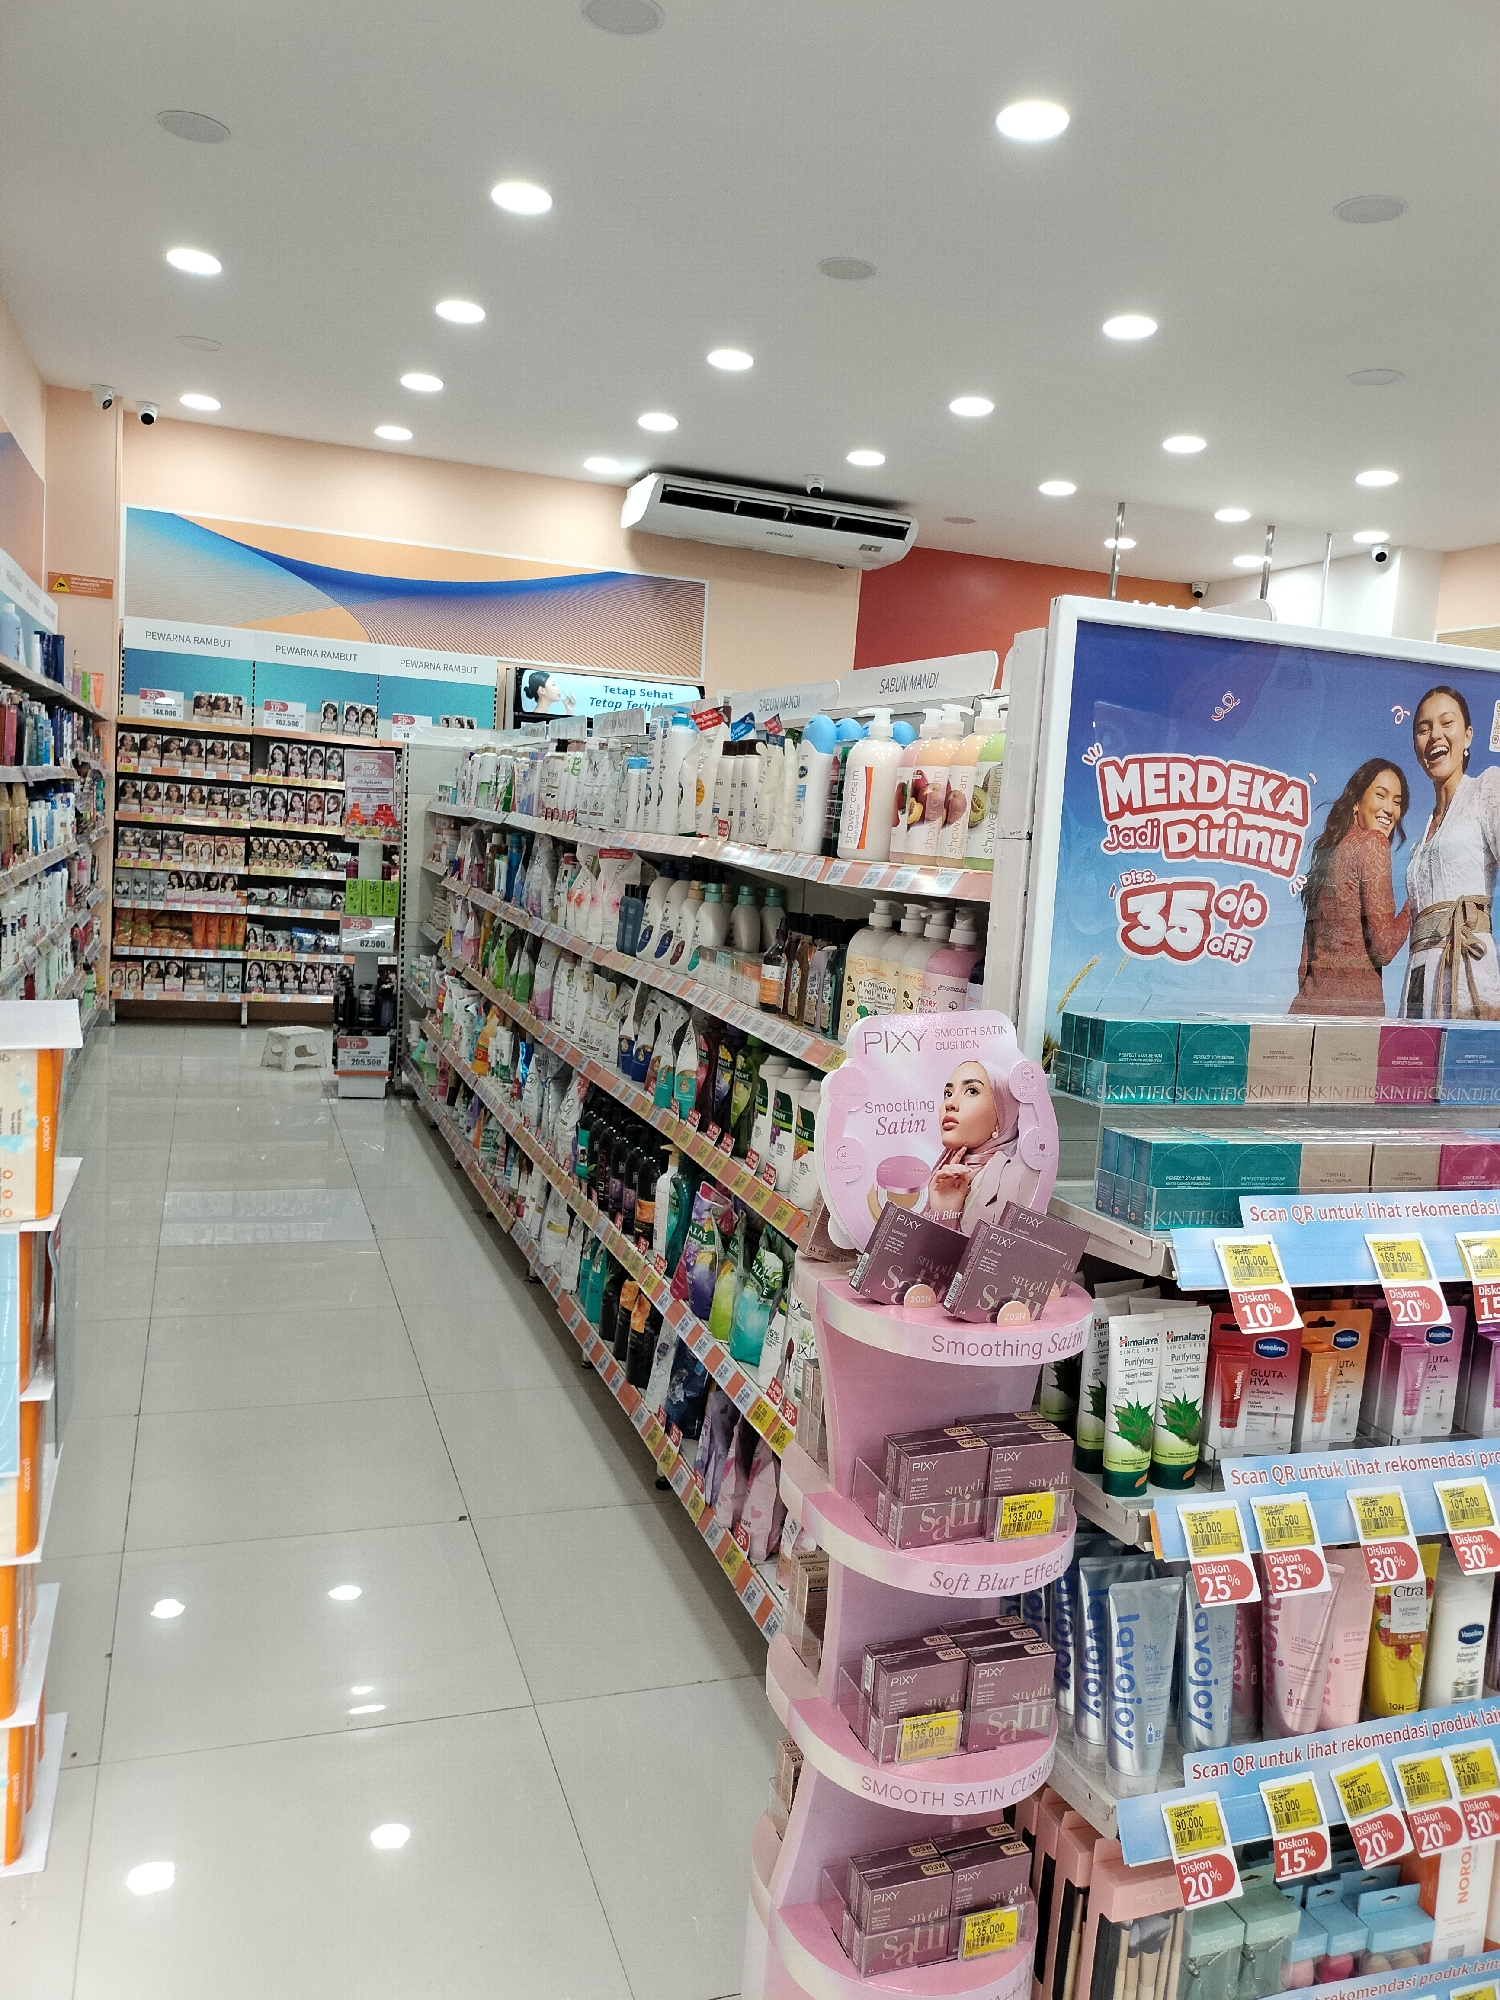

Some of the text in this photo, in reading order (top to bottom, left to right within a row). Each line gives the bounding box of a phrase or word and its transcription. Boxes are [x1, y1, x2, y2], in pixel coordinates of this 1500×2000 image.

[145, 631, 232, 648] PEWARNA RAMBUT
[275, 645, 358, 661] PEWARNA RAMBUT
[401, 659, 478, 674] PEWARNA RAMBUT
[879, 672, 940, 694] SABUN MANDI
[603, 685, 673, 699] Tetap Sehat
[590, 697, 622, 711] Tetap
[1101, 760, 1306, 822] MERDEKA
[844, 770, 859, 844] shower cream
[1103, 817, 1298, 871] Jadi Dirimu
[864, 1026, 1008, 1054] PIXY SMOOTH SATIN
[935, 1040, 981, 1051] CUSHION
[1096, 1085, 1175, 1099] SKINTIFIC
[1176, 1087, 1247, 1101] SKINTIFIC
[1310, 1086, 1377, 1098] SKINTIFIC
[1374, 1086, 1438, 1099] SKINTIFIC
[864, 1098, 935, 1115] Smoothing
[875, 1113, 927, 1136] Satin
[42, 1115, 50, 1152] guardian
[942, 1210, 963, 1220] Blur
[1144, 1211, 1229, 1225] SKINTIFIC
[1250, 1205, 1288, 1223] Scan
[1291, 1205, 1314, 1224] QR
[1318, 1203, 1364, 1220] untuk
[1367, 1201, 1402, 1218] lihat
[1405, 1198, 1500, 1217] rekomendasi
[896, 1214, 922, 1231] PIXY
[1018, 1212, 1043, 1229] PIXY
[989, 1232, 1017, 1249] PIXY
[910, 1295, 931, 1303] 302N
[1237, 1293, 1270, 1304] Diskon
[1389, 1288, 1420, 1299] Diskon
[1004, 1313, 1026, 1321] 202N
[1241, 1303, 1281, 1328] 10%
[1392, 1300, 1430, 1322] 20%
[932, 1326, 1084, 1360] Smoothing Satin
[1119, 1336, 1159, 1347] Himalaya
[1166, 1330, 1206, 1343] Himalaya
[1124, 1357, 1154, 1367] Purifying
[1171, 1352, 1201, 1362] Purifying
[1250, 1378, 1270, 1387] HYA
[996, 1452, 1022, 1463] PIXY
[912, 1460, 939, 1472] PIXY
[1231, 1450, 1477, 1485] Scan QR untuk lihat rekomendasi
[1450, 1497, 1479, 1509] 101.500
[1007, 1509, 1043, 1523] 135.000
[1362, 1506, 1393, 1518] 101.500
[1193, 1522, 1222, 1535] 33.000
[1266, 1515, 1300, 1528] 101.500
[1455, 1534, 1484, 1545] Diskon
[1367, 1546, 1396, 1557] Diskon
[1459, 1544, 1493, 1569] 30%
[1269, 1553, 1301, 1565] Diskon
[929, 1554, 1064, 1595] Soft Blur Effect
[1198, 1564, 1230, 1575] Diskon
[1370, 1556, 1406, 1581] 30%
[1272, 1564, 1311, 1591] 35%
[1200, 1575, 1240, 1602] 25%
[1394, 1585, 1424, 1597] Citra
[940, 1650, 961, 1658] 301C
[1028, 1643, 1048, 1651] 301C
[1456, 1651, 1478, 1659] Advanced
[1456, 1656, 1476, 1664] Strength
[978, 1666, 1005, 1678] PIXY
[890, 1674, 918, 1687] PIXY
[1111, 1613, 1142, 1751] lavojoy
[909, 1725, 945, 1741] 135.000
[1192, 1712, 1480, 1780] Scan QR untuk lihat rekomendasi produk
[1455, 1762, 1480, 1775] 34.500
[1405, 1772, 1430, 1786] 25.500
[861, 1776, 1004, 1807] SMOOTH SATIN
[1347, 1784, 1371, 1800] 42.500
[1274, 1799, 1300, 1813] 63.000
[1464, 1801, 1489, 1812] Diskon
[1175, 1816, 1204, 1831] 90.000
[1413, 1811, 1441, 1826] Diskon
[1467, 1810, 1499, 1838] 30%
[1355, 1820, 1383, 1837] Diskon
[1417, 1821, 1451, 1851] 20%
[911, 1845, 933, 1854] 303W
[1278, 1838, 1309, 1850] Diskon
[1359, 1829, 1394, 1863] 20%
[923, 1862, 946, 1872] 303W
[1181, 1859, 1212, 1875] Diskon
[1280, 1847, 1316, 1876] 15%
[958, 1870, 982, 1884] PIXY
[1183, 1870, 1222, 1903] 20%
[873, 1891, 900, 1904] PIXY
[971, 1922, 1005, 1938] 135.000
[1419, 1966, 1469, 1987] produk
